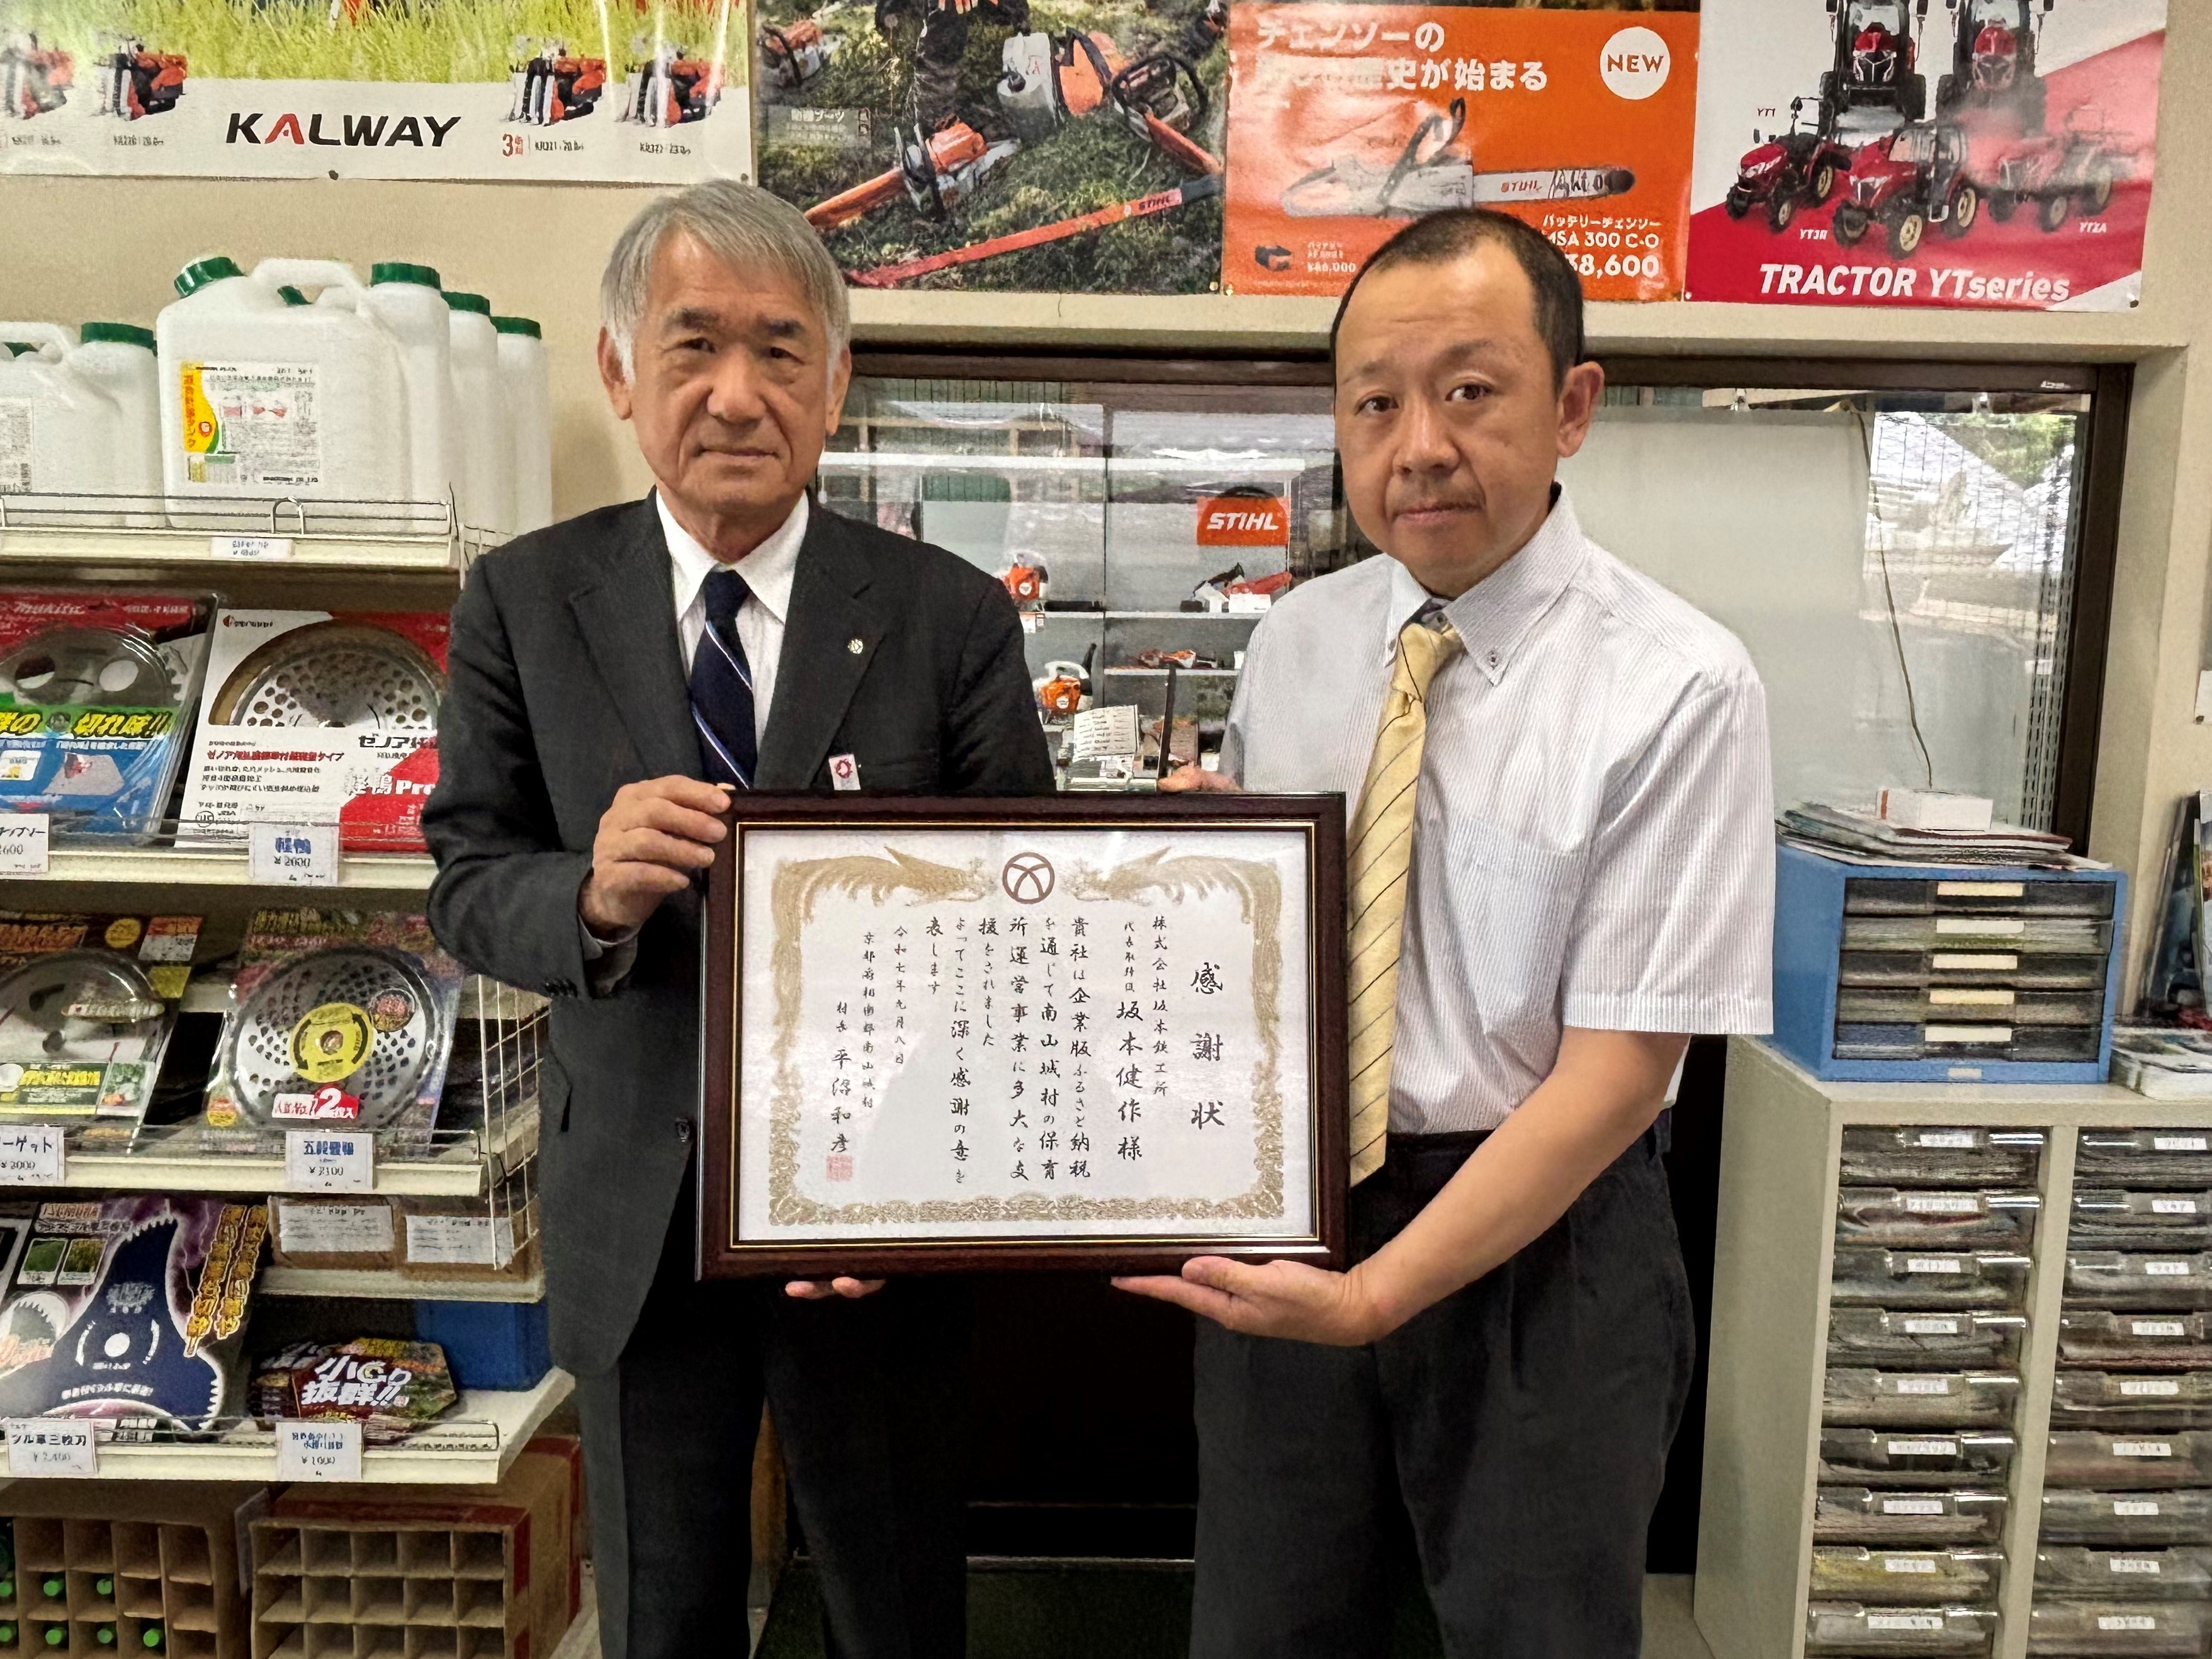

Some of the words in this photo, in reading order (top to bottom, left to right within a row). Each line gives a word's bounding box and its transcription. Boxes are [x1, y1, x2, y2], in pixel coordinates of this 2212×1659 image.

[1258, 21, 1445, 53] チェンソーの
[1607, 54, 1664, 73] NEW
[226, 113, 461, 147] KALWAY
[1543, 214, 1662, 230] バッテリーチェンソー
[1584, 231, 1620, 248] 300
[1760, 263, 1917, 298] TRACTOR
[1929, 268, 2070, 303] YTseries
[1207, 512, 1279, 531] STIHL
[893, 925, 908, 1065] 令和七年九月八日
[925, 917, 944, 995] 表します
[978, 917, 1000, 1046] 援をされました
[1151, 915, 1168, 1097] 株式会社坂本鉄工所
[948, 917, 971, 1184] よってここに深く感謝の意を
[1008, 916, 1030, 1181] 所運営事業に多大な支
[1038, 917, 1060, 1180] を通じて南山城村の保育
[1068, 917, 1092, 1178] 貴社は企業版ふるさと納税
[1115, 1000, 1144, 1161] 坂本健作様
[1190, 962, 1225, 1130] 感謝状
[0, 1135, 52, 1153] ーゲット
